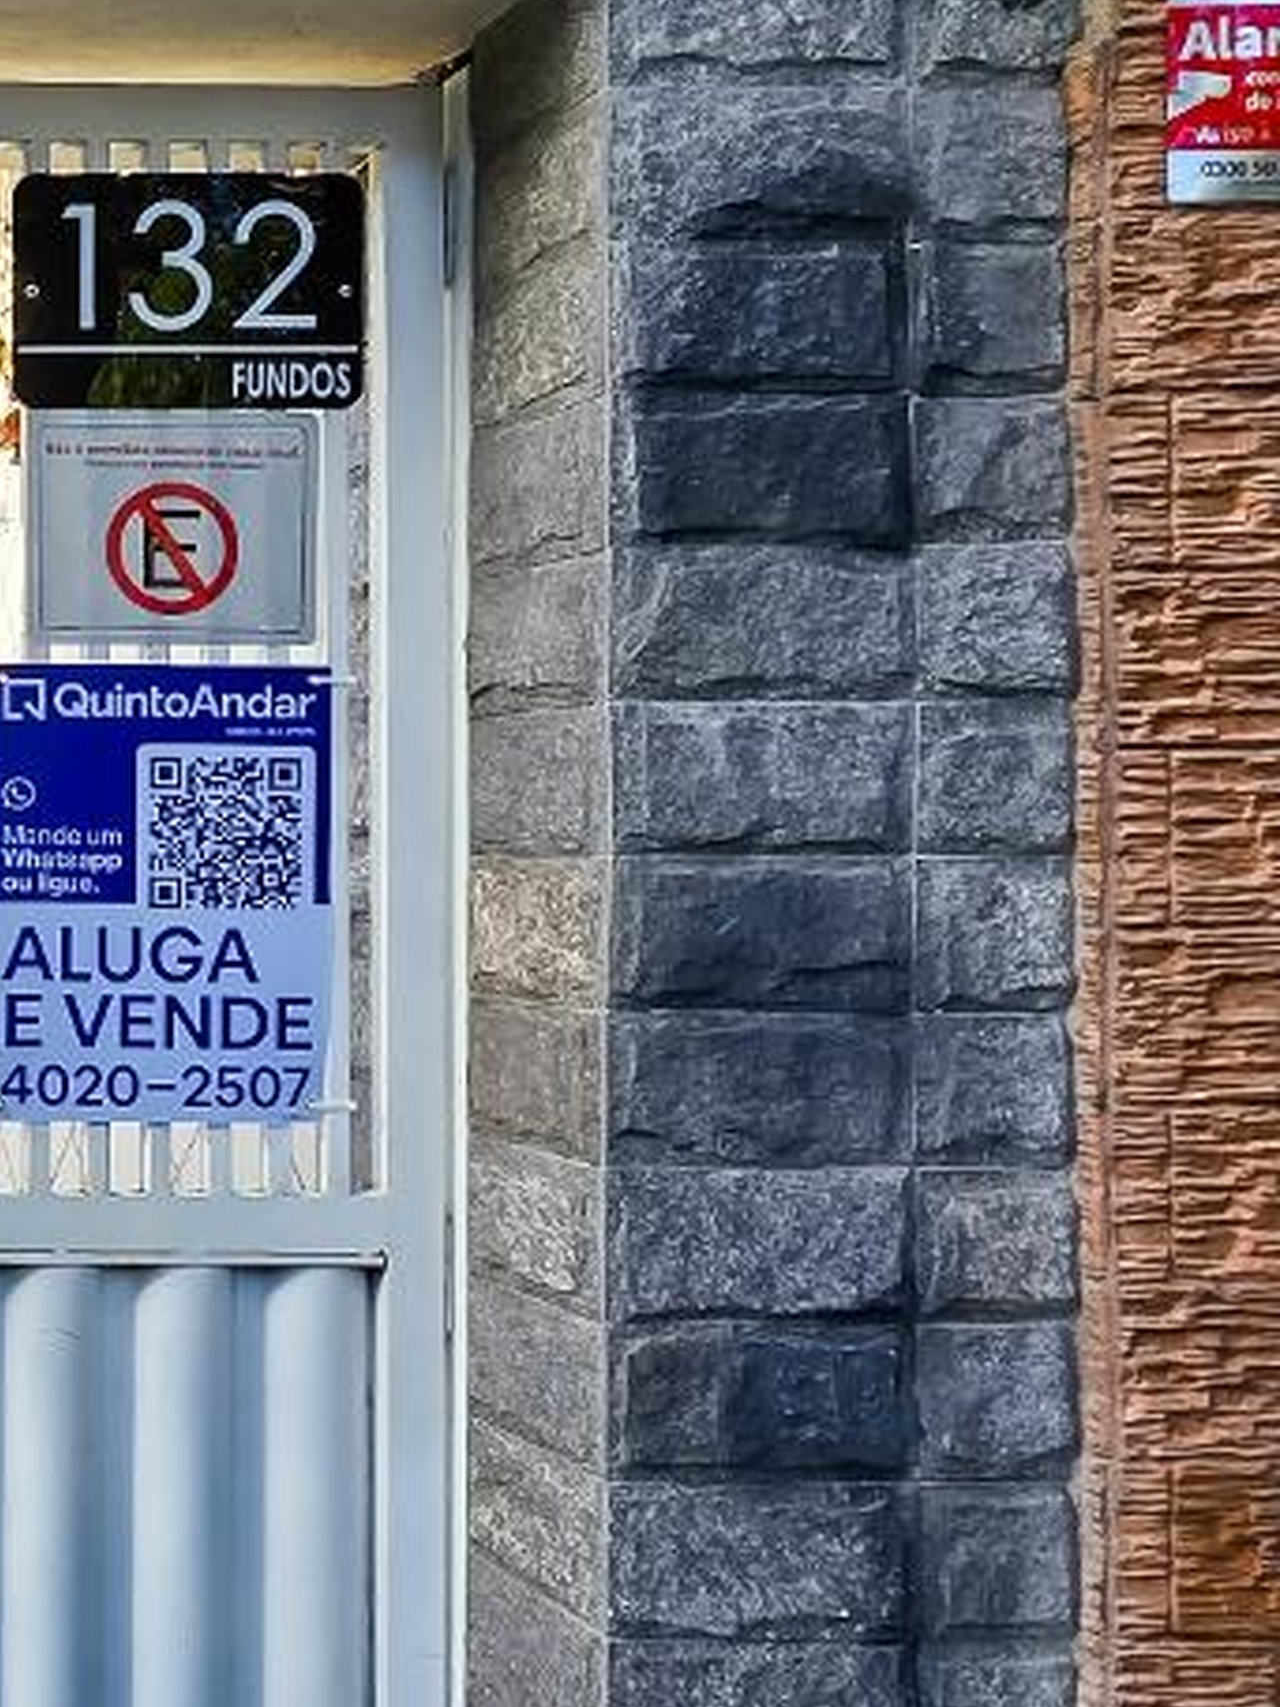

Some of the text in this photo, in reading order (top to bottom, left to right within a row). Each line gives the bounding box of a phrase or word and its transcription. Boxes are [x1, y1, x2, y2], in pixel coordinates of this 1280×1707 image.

[60, 198, 318, 332] 132
[231, 362, 353, 400] FUNDOS
[53, 682, 318, 719] QuintoAndar
[87, 829, 123, 845] um
[1, 873, 101, 898] ou ligue.
[1, 925, 261, 984] ALUGA
[4, 994, 314, 1051] E VENDE
[0, 1064, 311, 1109] 4020-2507
